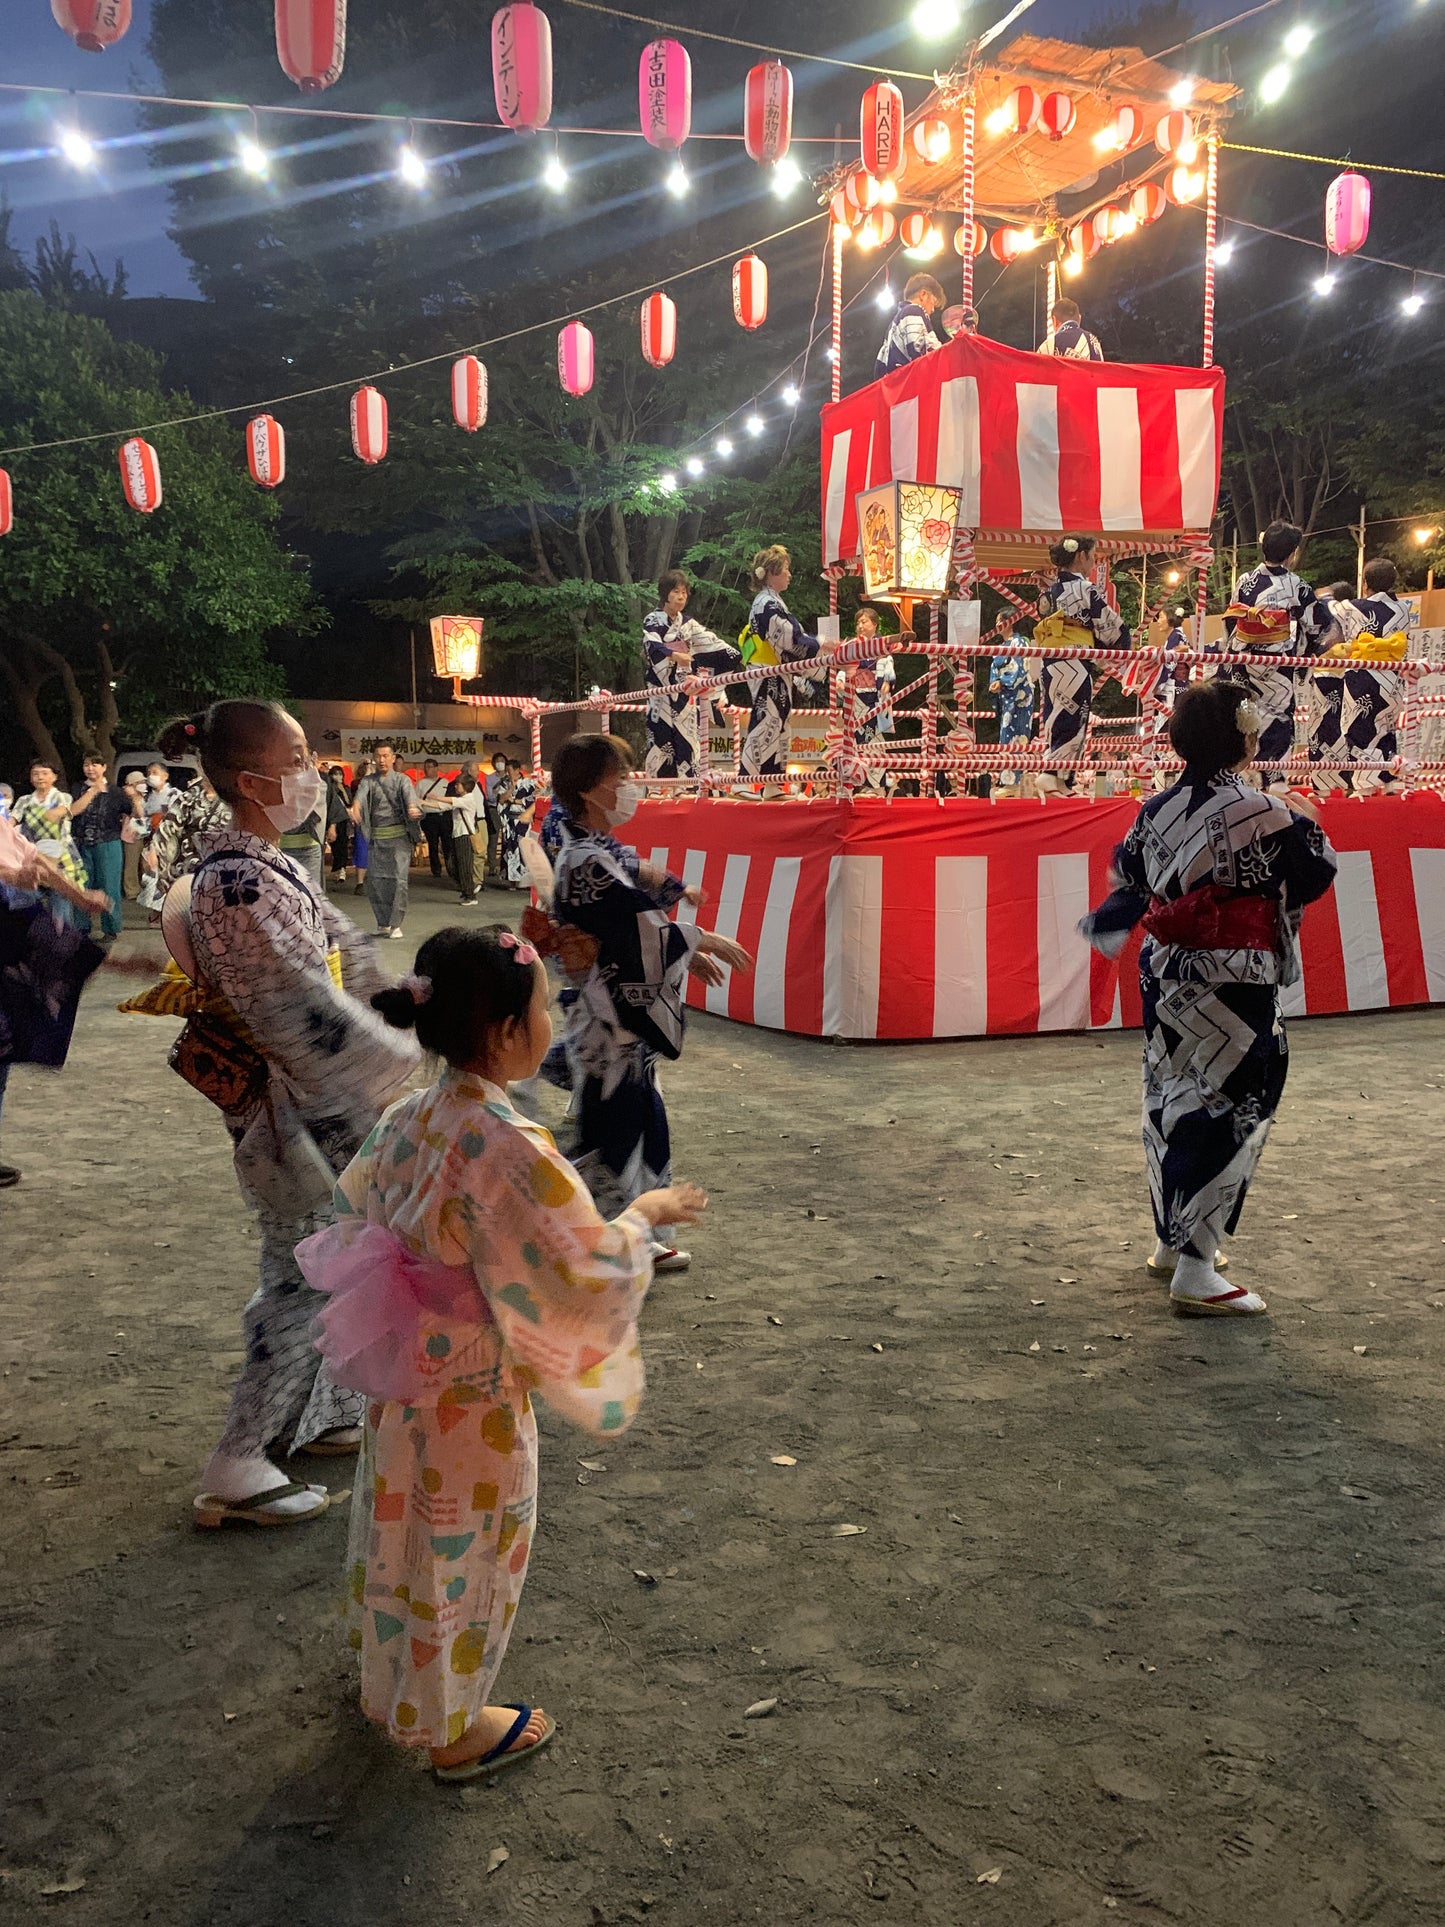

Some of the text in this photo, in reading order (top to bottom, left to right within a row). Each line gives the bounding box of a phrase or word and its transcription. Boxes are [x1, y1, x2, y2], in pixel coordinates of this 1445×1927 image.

[497, 11, 523, 119] インテージ
[876, 101, 890, 165] HARE
